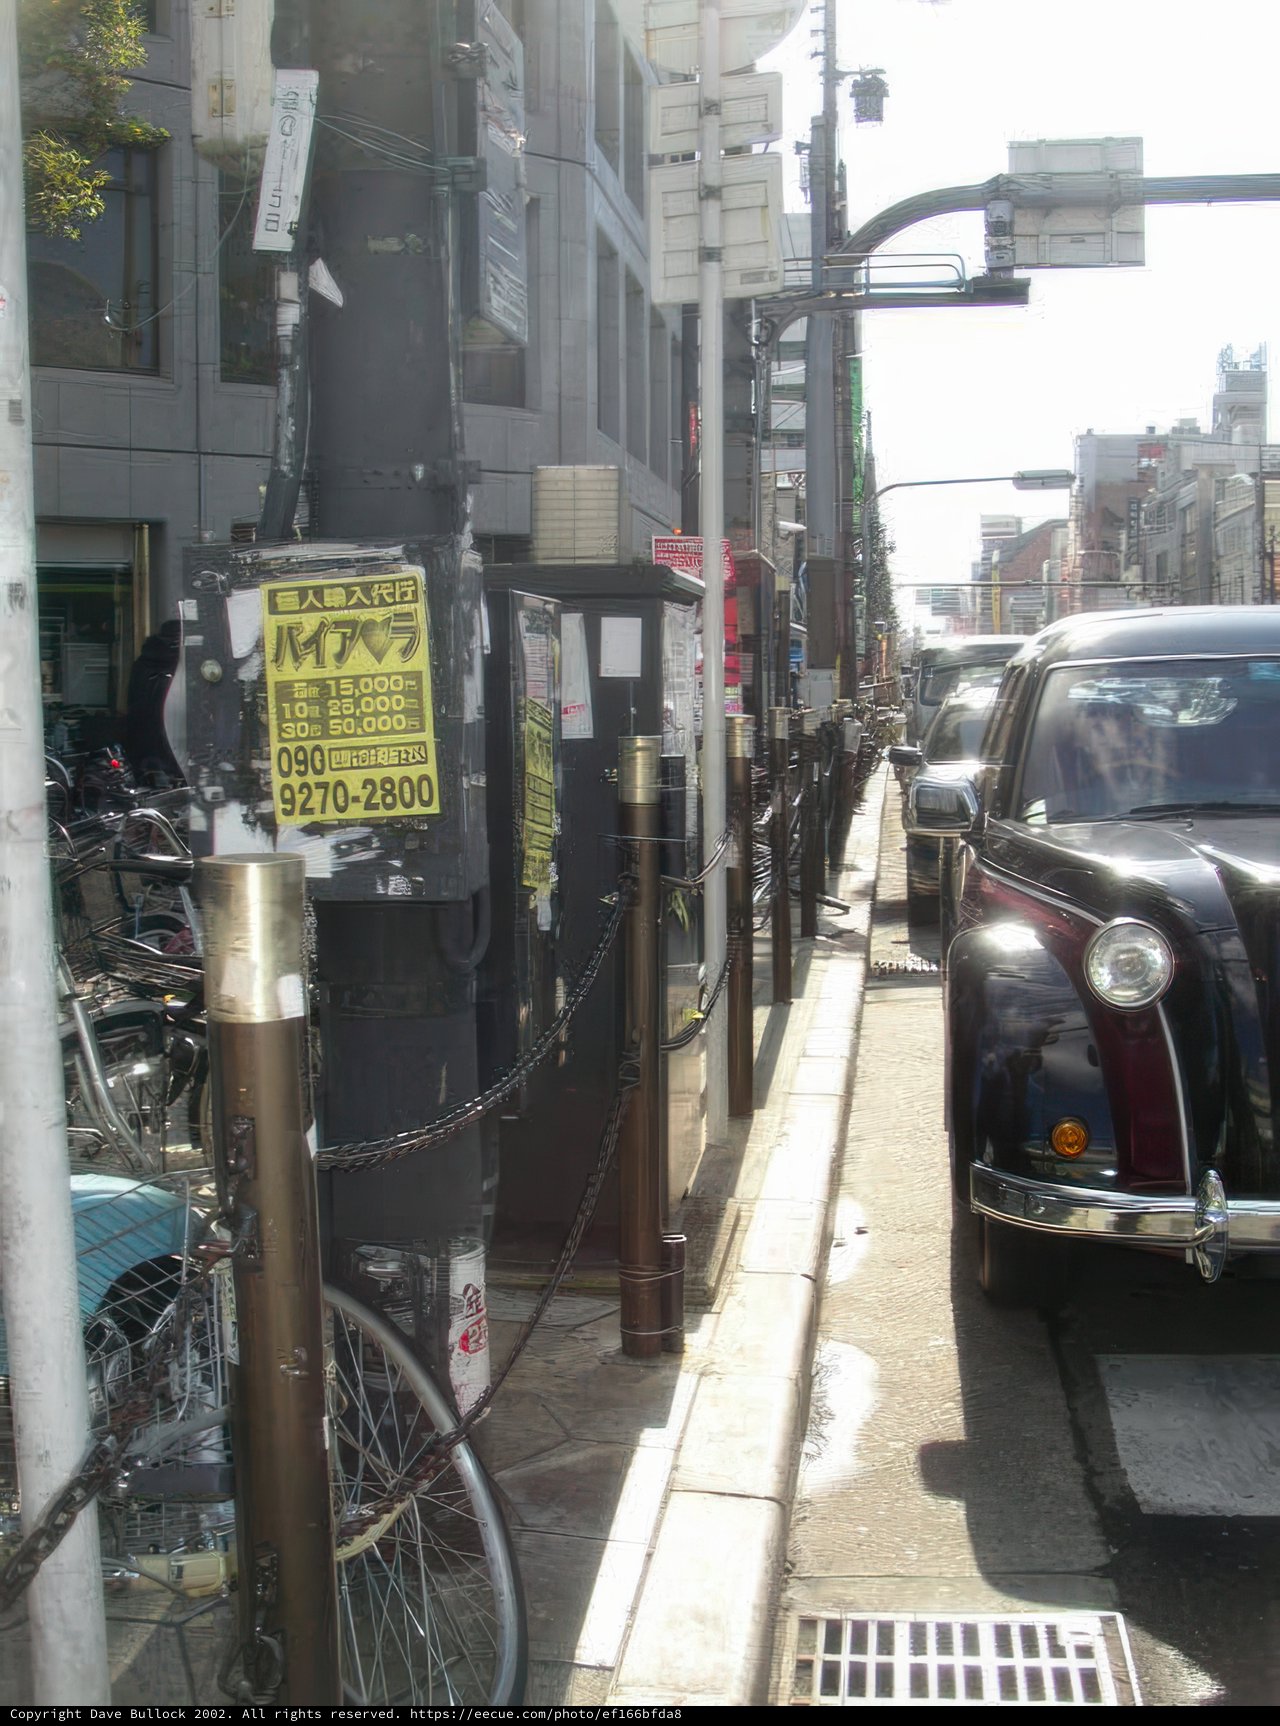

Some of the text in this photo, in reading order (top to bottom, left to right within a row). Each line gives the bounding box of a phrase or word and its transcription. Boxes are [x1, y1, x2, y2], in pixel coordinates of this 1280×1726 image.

[275, 580, 416, 612] 人入代行
[277, 743, 326, 778] 090
[279, 773, 434, 816] 9270-2800
